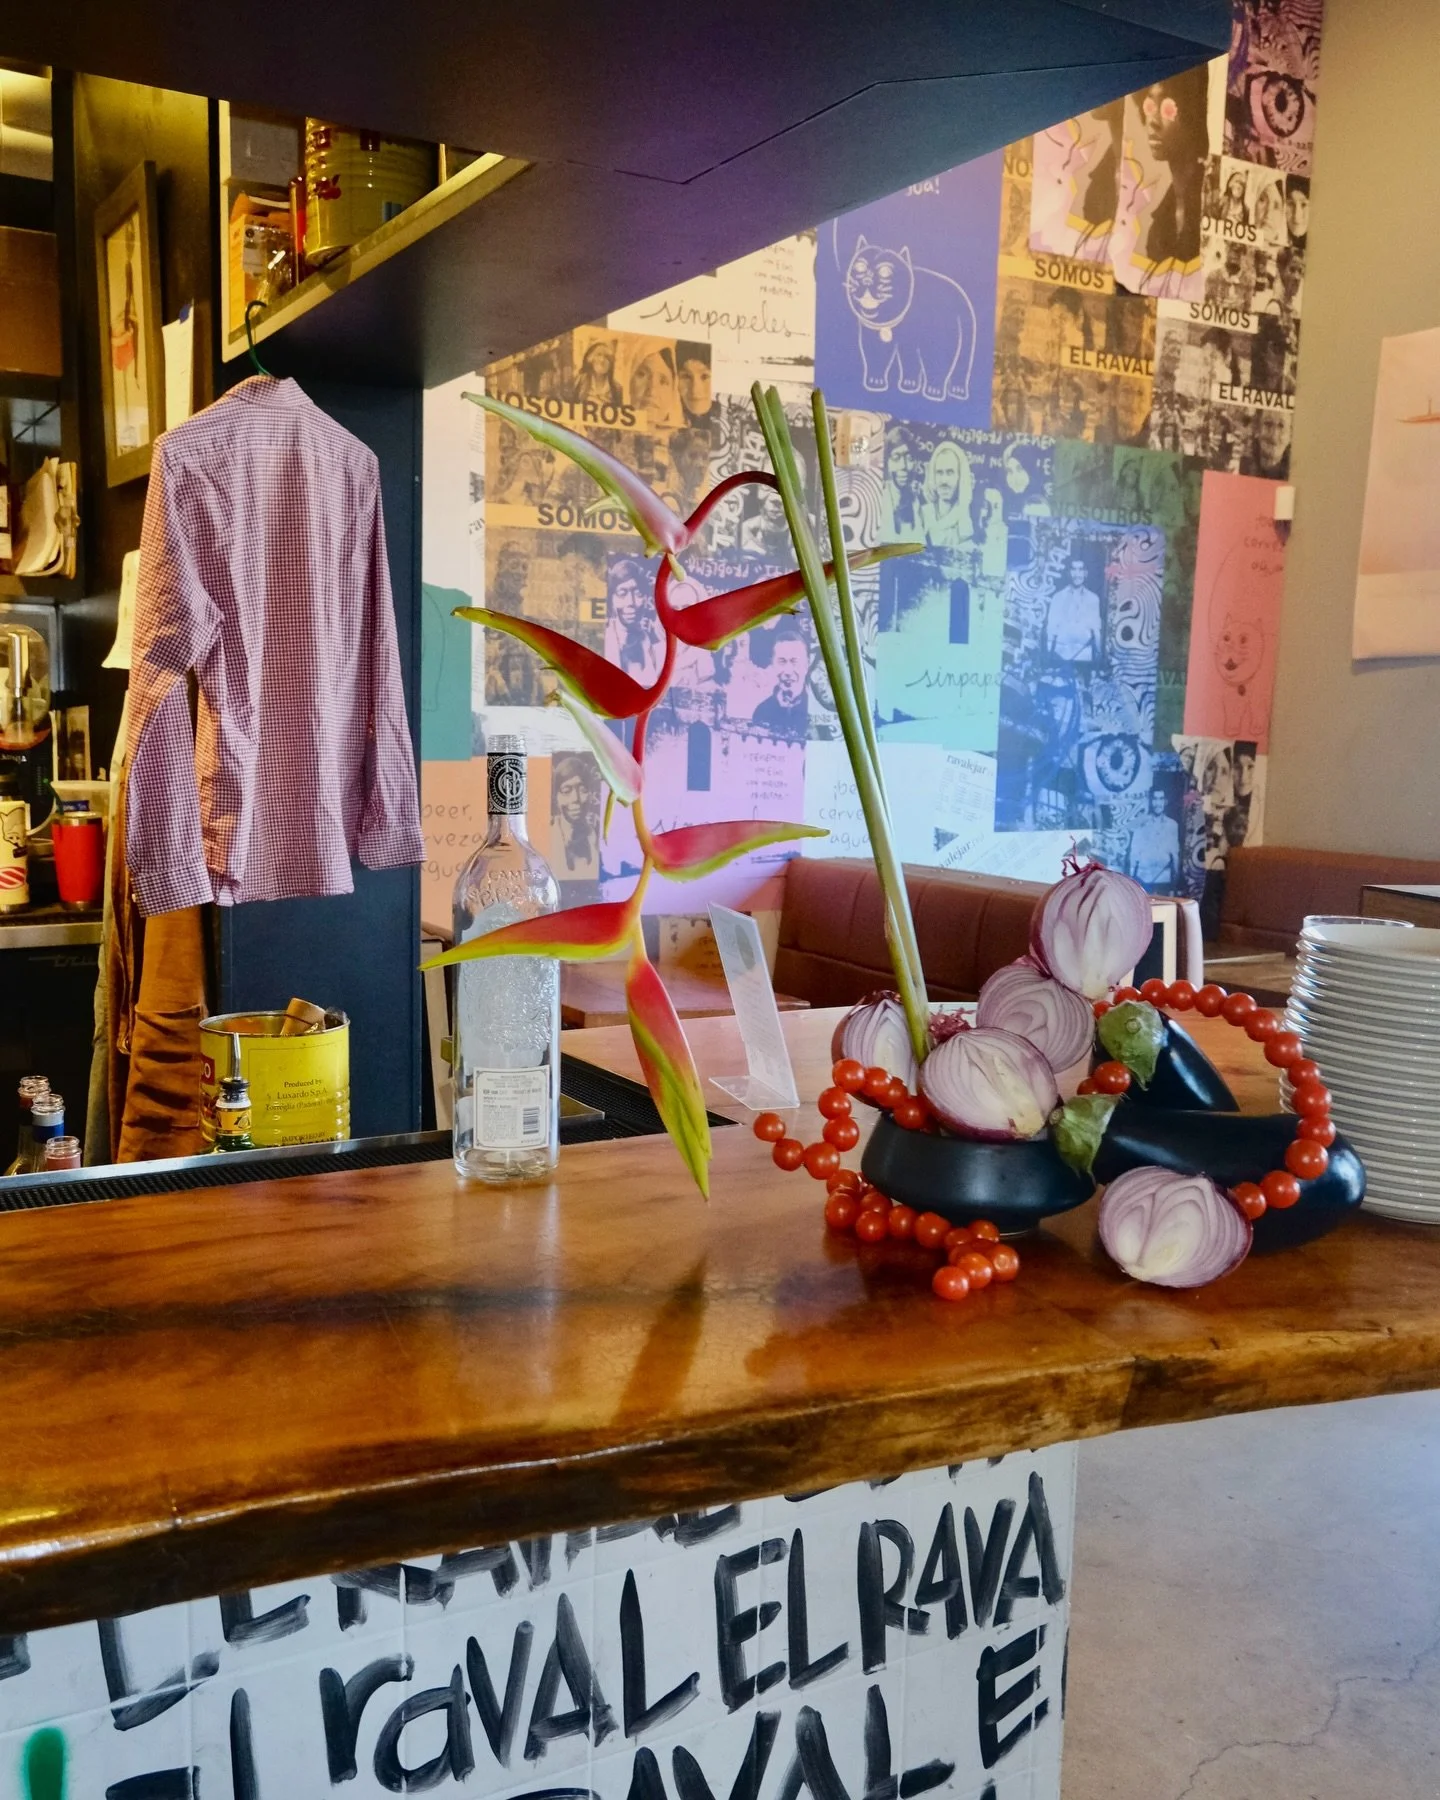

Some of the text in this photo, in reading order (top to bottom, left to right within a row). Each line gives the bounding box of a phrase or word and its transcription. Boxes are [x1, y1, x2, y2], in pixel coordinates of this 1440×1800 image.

[1035, 258, 1105, 289] SOMOS
[1190, 302, 1250, 329] SOMOS
[1070, 347, 1153, 377] EL RAVAL
[485, 389, 636, 427] OSOTROS
[1219, 384, 1294, 410] EL RAVAL
[538, 503, 634, 532] SOMOS
[277, 1091, 309, 1100] Luxardo
[284, 1080, 314, 1089] Produced
[714, 1527, 850, 1715] EL
